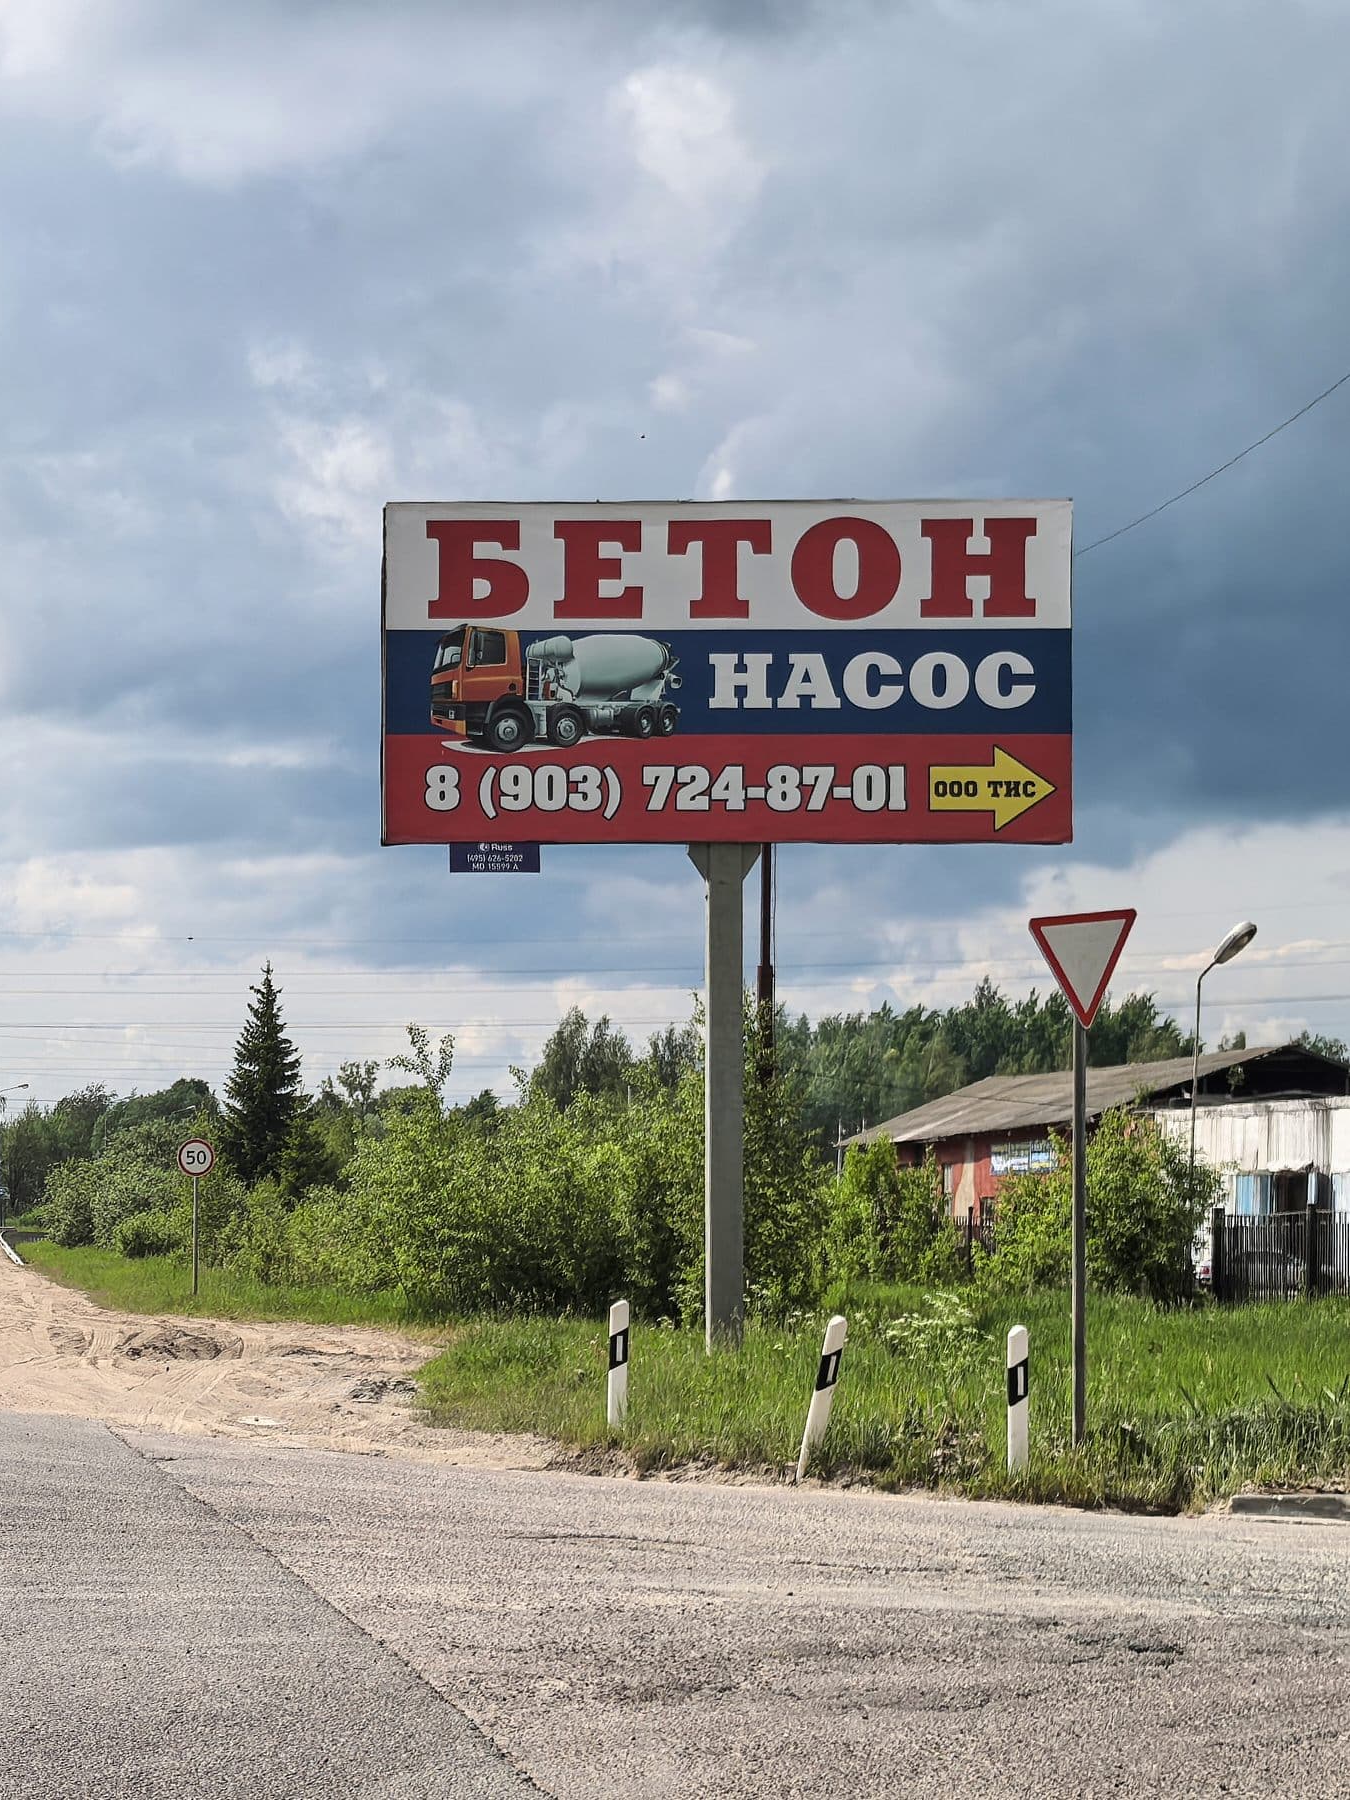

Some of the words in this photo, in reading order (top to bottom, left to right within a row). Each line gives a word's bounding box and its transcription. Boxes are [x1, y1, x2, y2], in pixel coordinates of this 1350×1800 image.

[426, 517, 1037, 620] БЕТОН
[708, 651, 1036, 710] НАСОС
[424, 764, 461, 812] 8
[478, 764, 622, 820] (903)
[641, 764, 908, 812] 724-87-01
[934, 780, 978, 798] ООО
[987, 780, 1036, 798] ТИС
[491, 843, 513, 851] Russ
[186, 1150, 207, 1165] 50
